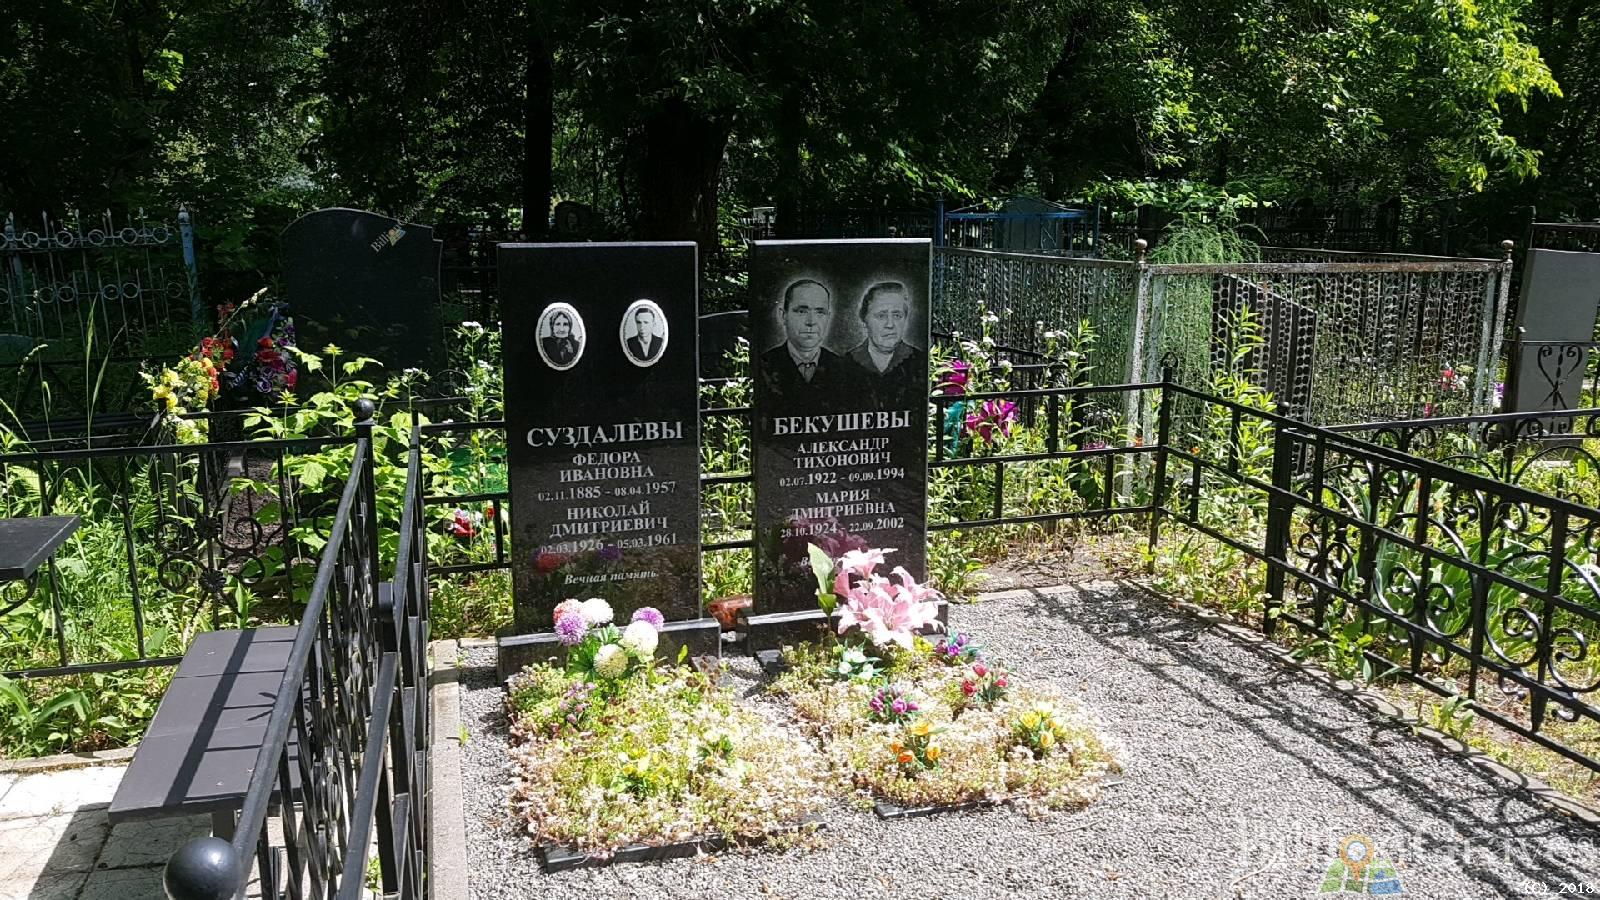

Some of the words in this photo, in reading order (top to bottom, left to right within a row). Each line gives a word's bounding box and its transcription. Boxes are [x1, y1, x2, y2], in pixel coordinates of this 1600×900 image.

[773, 410, 911, 436] БЕКУШЕВЫ
[527, 421, 684, 448] СУЗДАЛЕВЫ
[797, 437, 889, 454] АЛЕКСАНДР
[572, 451, 642, 467] ФЕДОРА
[793, 452, 892, 469] ТИХОНОВИЧ
[559, 466, 654, 483] ИВАНОВНА
[779, 472, 837, 487] 02.07.1922
[848, 467, 905, 482] 09.09.1994
[537, 485, 601, 502] 02.11.1885
[614, 481, 676, 497] 08.04.1957
[815, 488, 870, 504] МАРИЯ
[566, 500, 651, 521] НИКОЛАЙ
[791, 501, 896, 521] ДМИТРИЕВНА
[549, 517, 668, 539] ДМИТРИЕВИЧ
[780, 522, 838, 539] 28.10.1924
[849, 517, 905, 533] 22.09.2002
[541, 539, 604, 555] 02.03.1926
[617, 533, 677, 550] 05.03.1961
[564, 573, 607, 586] Вечная
